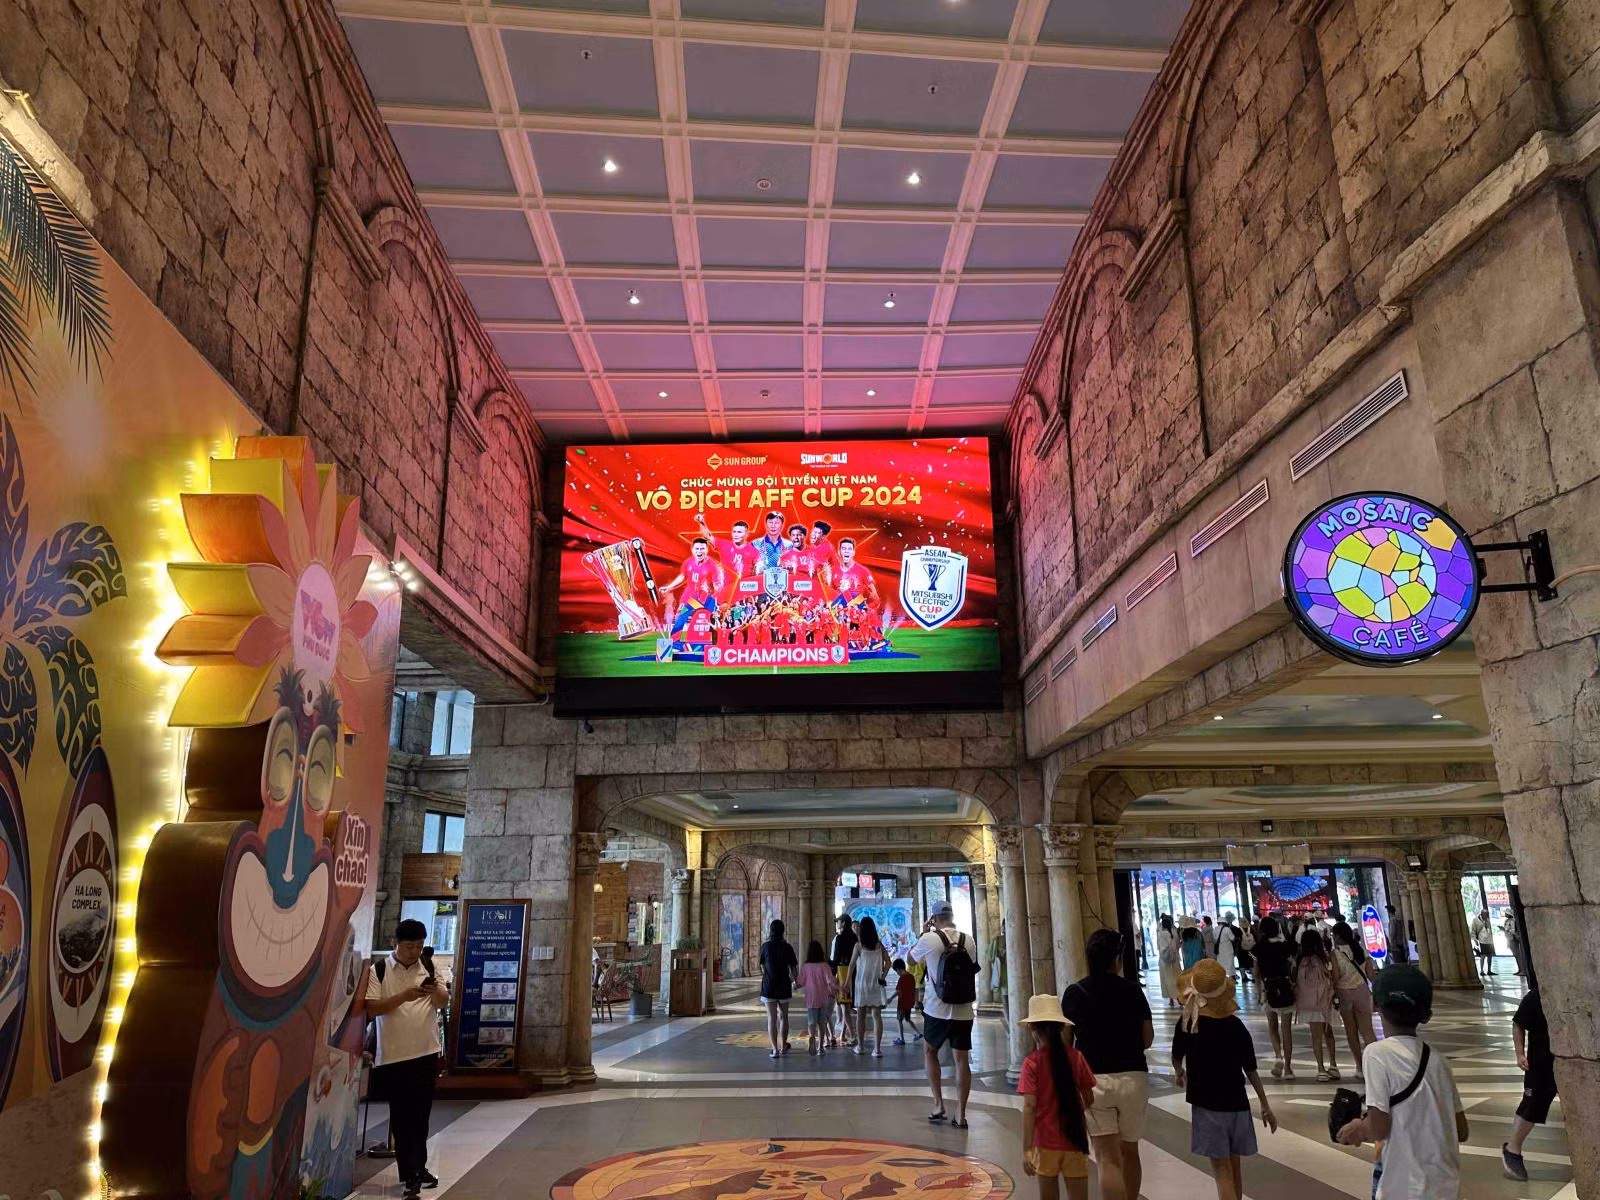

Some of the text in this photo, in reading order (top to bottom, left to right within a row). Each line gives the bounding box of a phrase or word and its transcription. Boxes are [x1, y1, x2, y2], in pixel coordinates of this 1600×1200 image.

[724, 456, 767, 466] SUN GROUP
[680, 473, 877, 488] CHÚC MỪNG ĐỘI TUYỂN VIỆT NAM
[635, 485, 922, 513] VÔ ĐỊCH AFF CUP 2024
[1317, 503, 1432, 538] MOSAIC
[924, 549, 947, 558] ASEAN
[913, 597, 950, 607] ELECTRIC
[919, 605, 943, 615] CUP
[1353, 620, 1430, 648] CAFÉ
[724, 648, 829, 663] CHAMPIONS
[344, 814, 366, 850] Xin
[75, 885, 102, 896] HA LONG
[72, 899, 101, 909] COMPLEX
